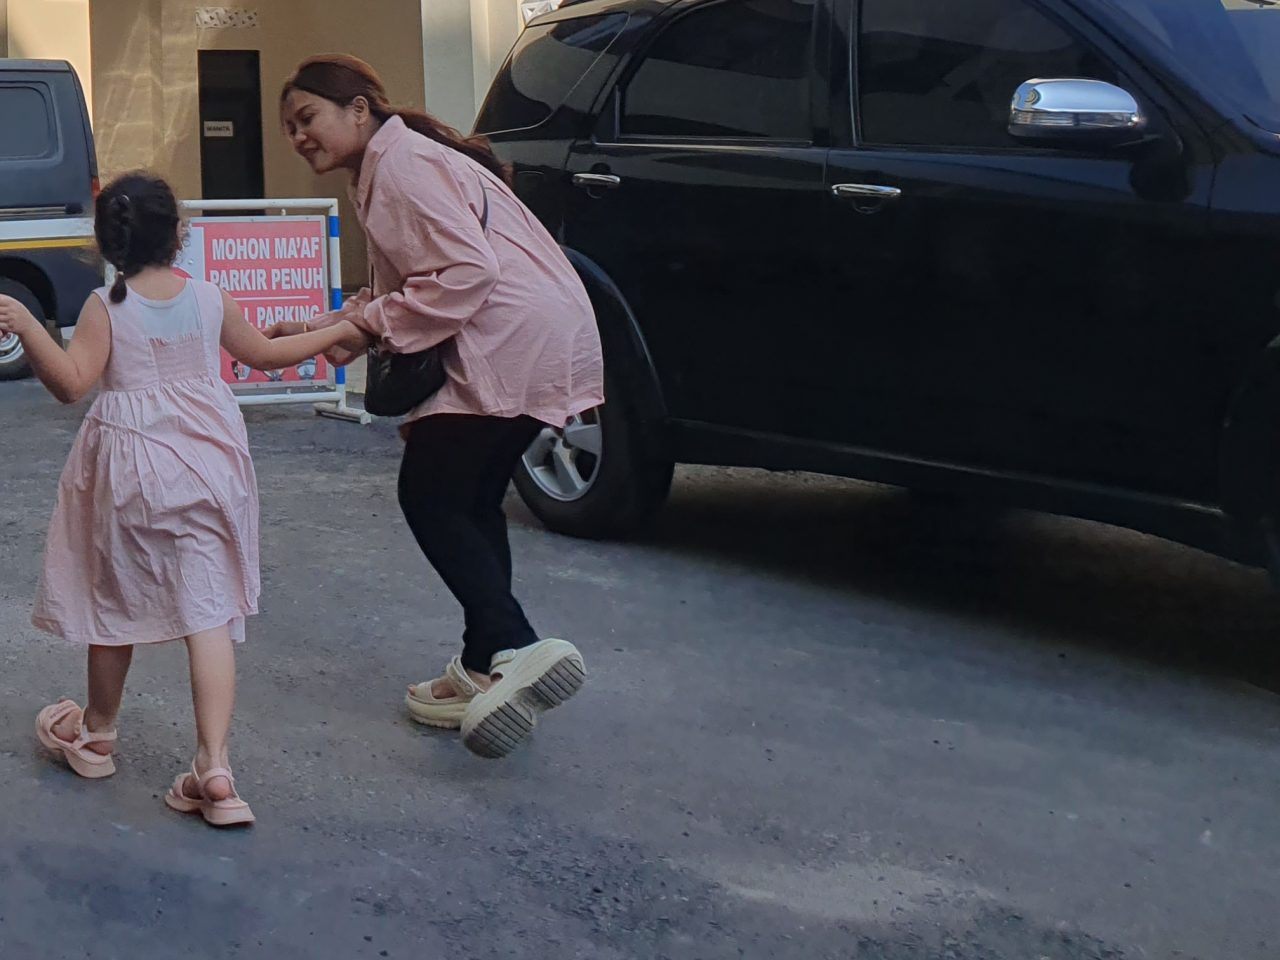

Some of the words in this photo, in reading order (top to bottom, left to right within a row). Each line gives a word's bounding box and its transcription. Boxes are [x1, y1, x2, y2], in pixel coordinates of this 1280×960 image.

[212, 238, 270, 260] MOHON
[274, 237, 320, 259] MA'AF
[210, 269, 268, 291] PARKIR
[271, 267, 324, 290] PENUH
